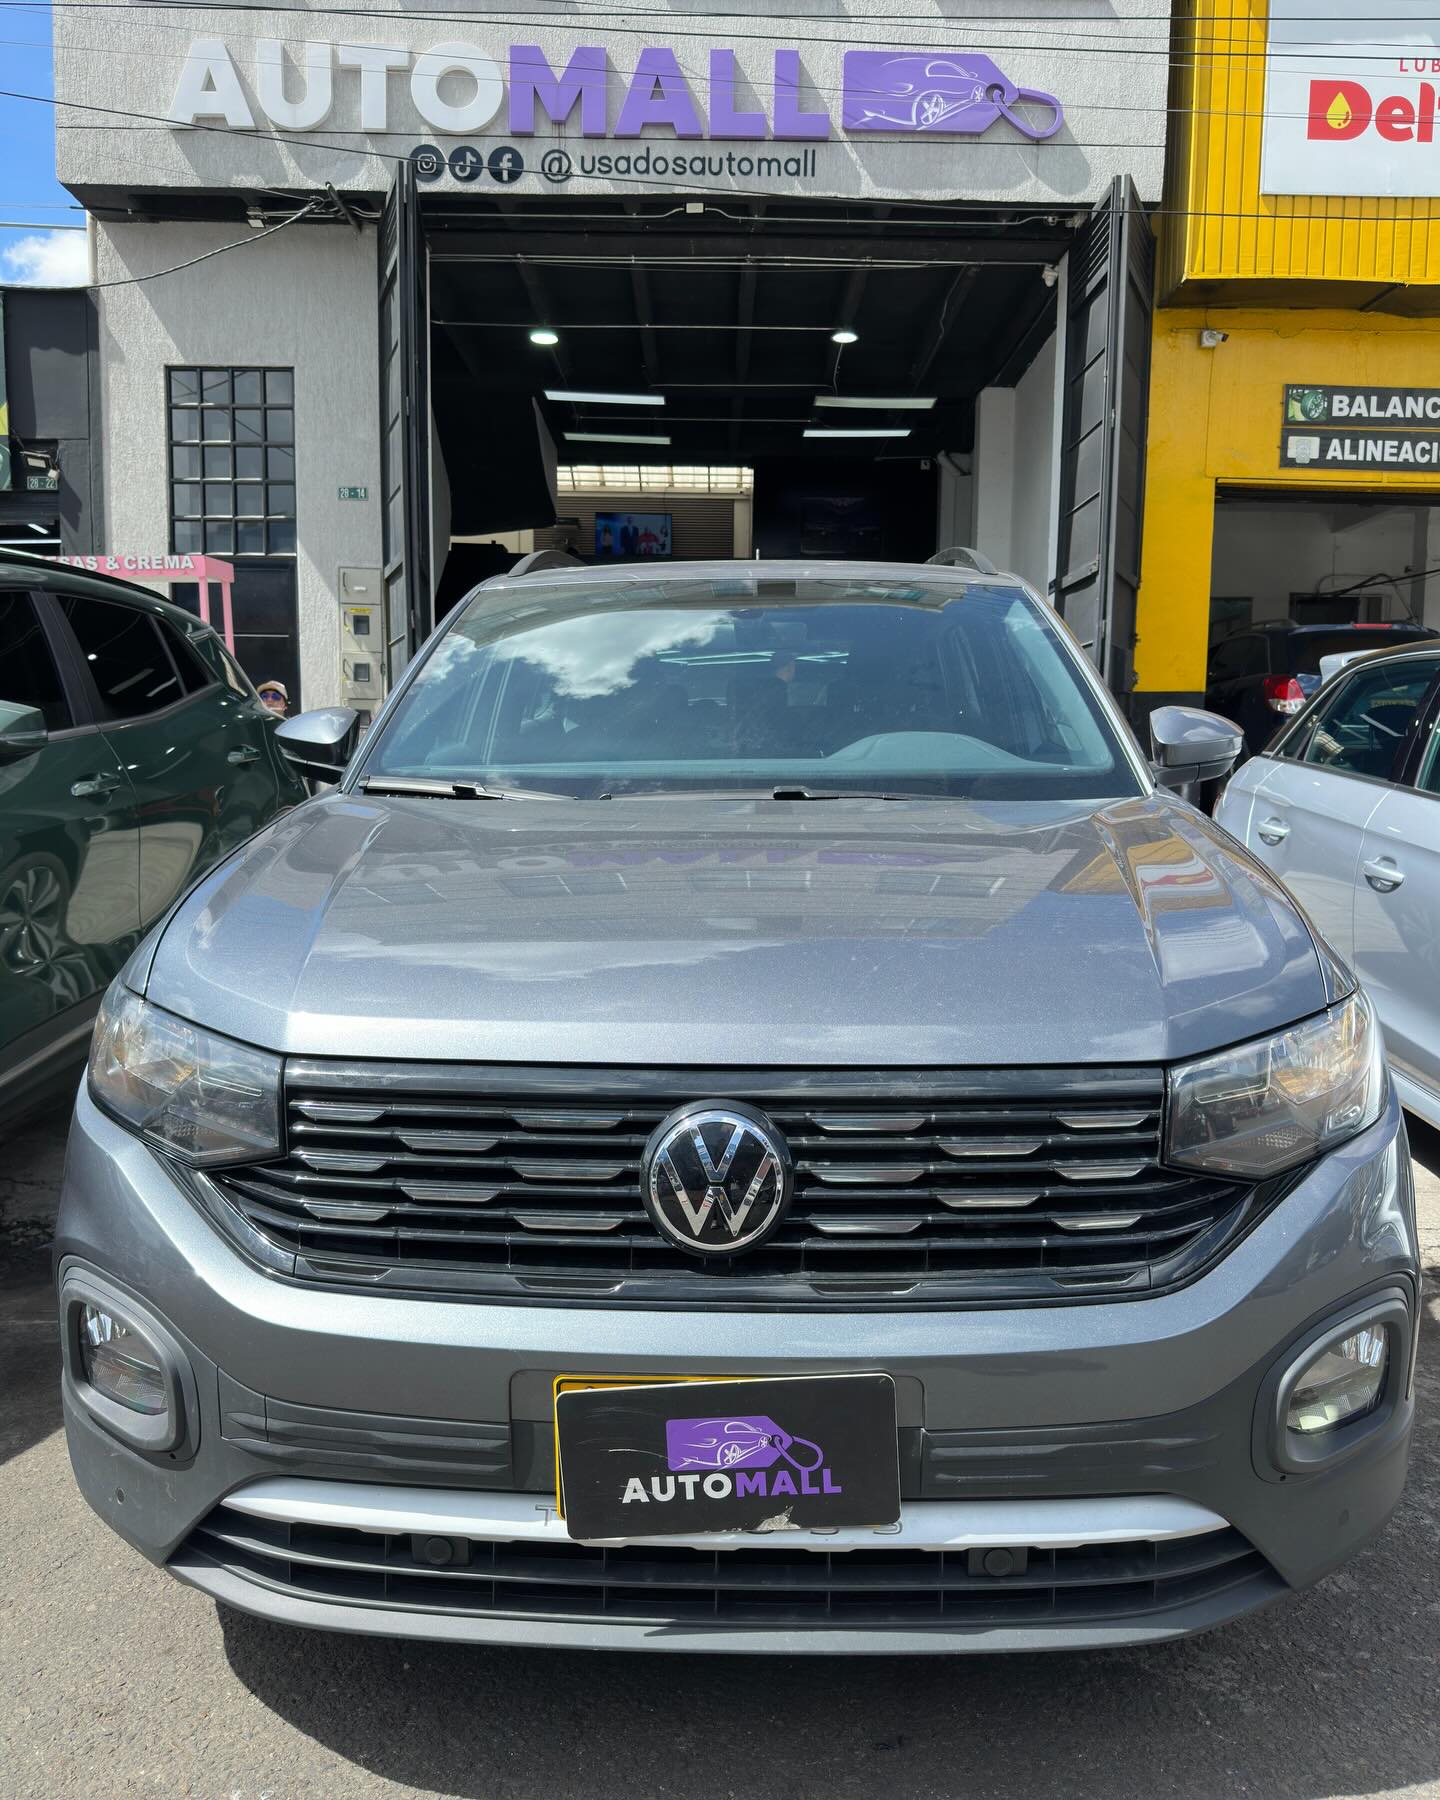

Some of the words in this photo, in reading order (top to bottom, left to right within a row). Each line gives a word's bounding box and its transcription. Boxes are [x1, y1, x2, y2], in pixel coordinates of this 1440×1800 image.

[168, 39, 829, 140] AUTOMALL
[1307, 80, 1440, 143] Del
[1332, 395, 1440, 419] BALANC
[1326, 438, 1440, 464] ALINEACI
[105, 555, 120, 570] &
[124, 555, 195, 570] CREMA
[622, 1468, 842, 1504] AUTOMALL
